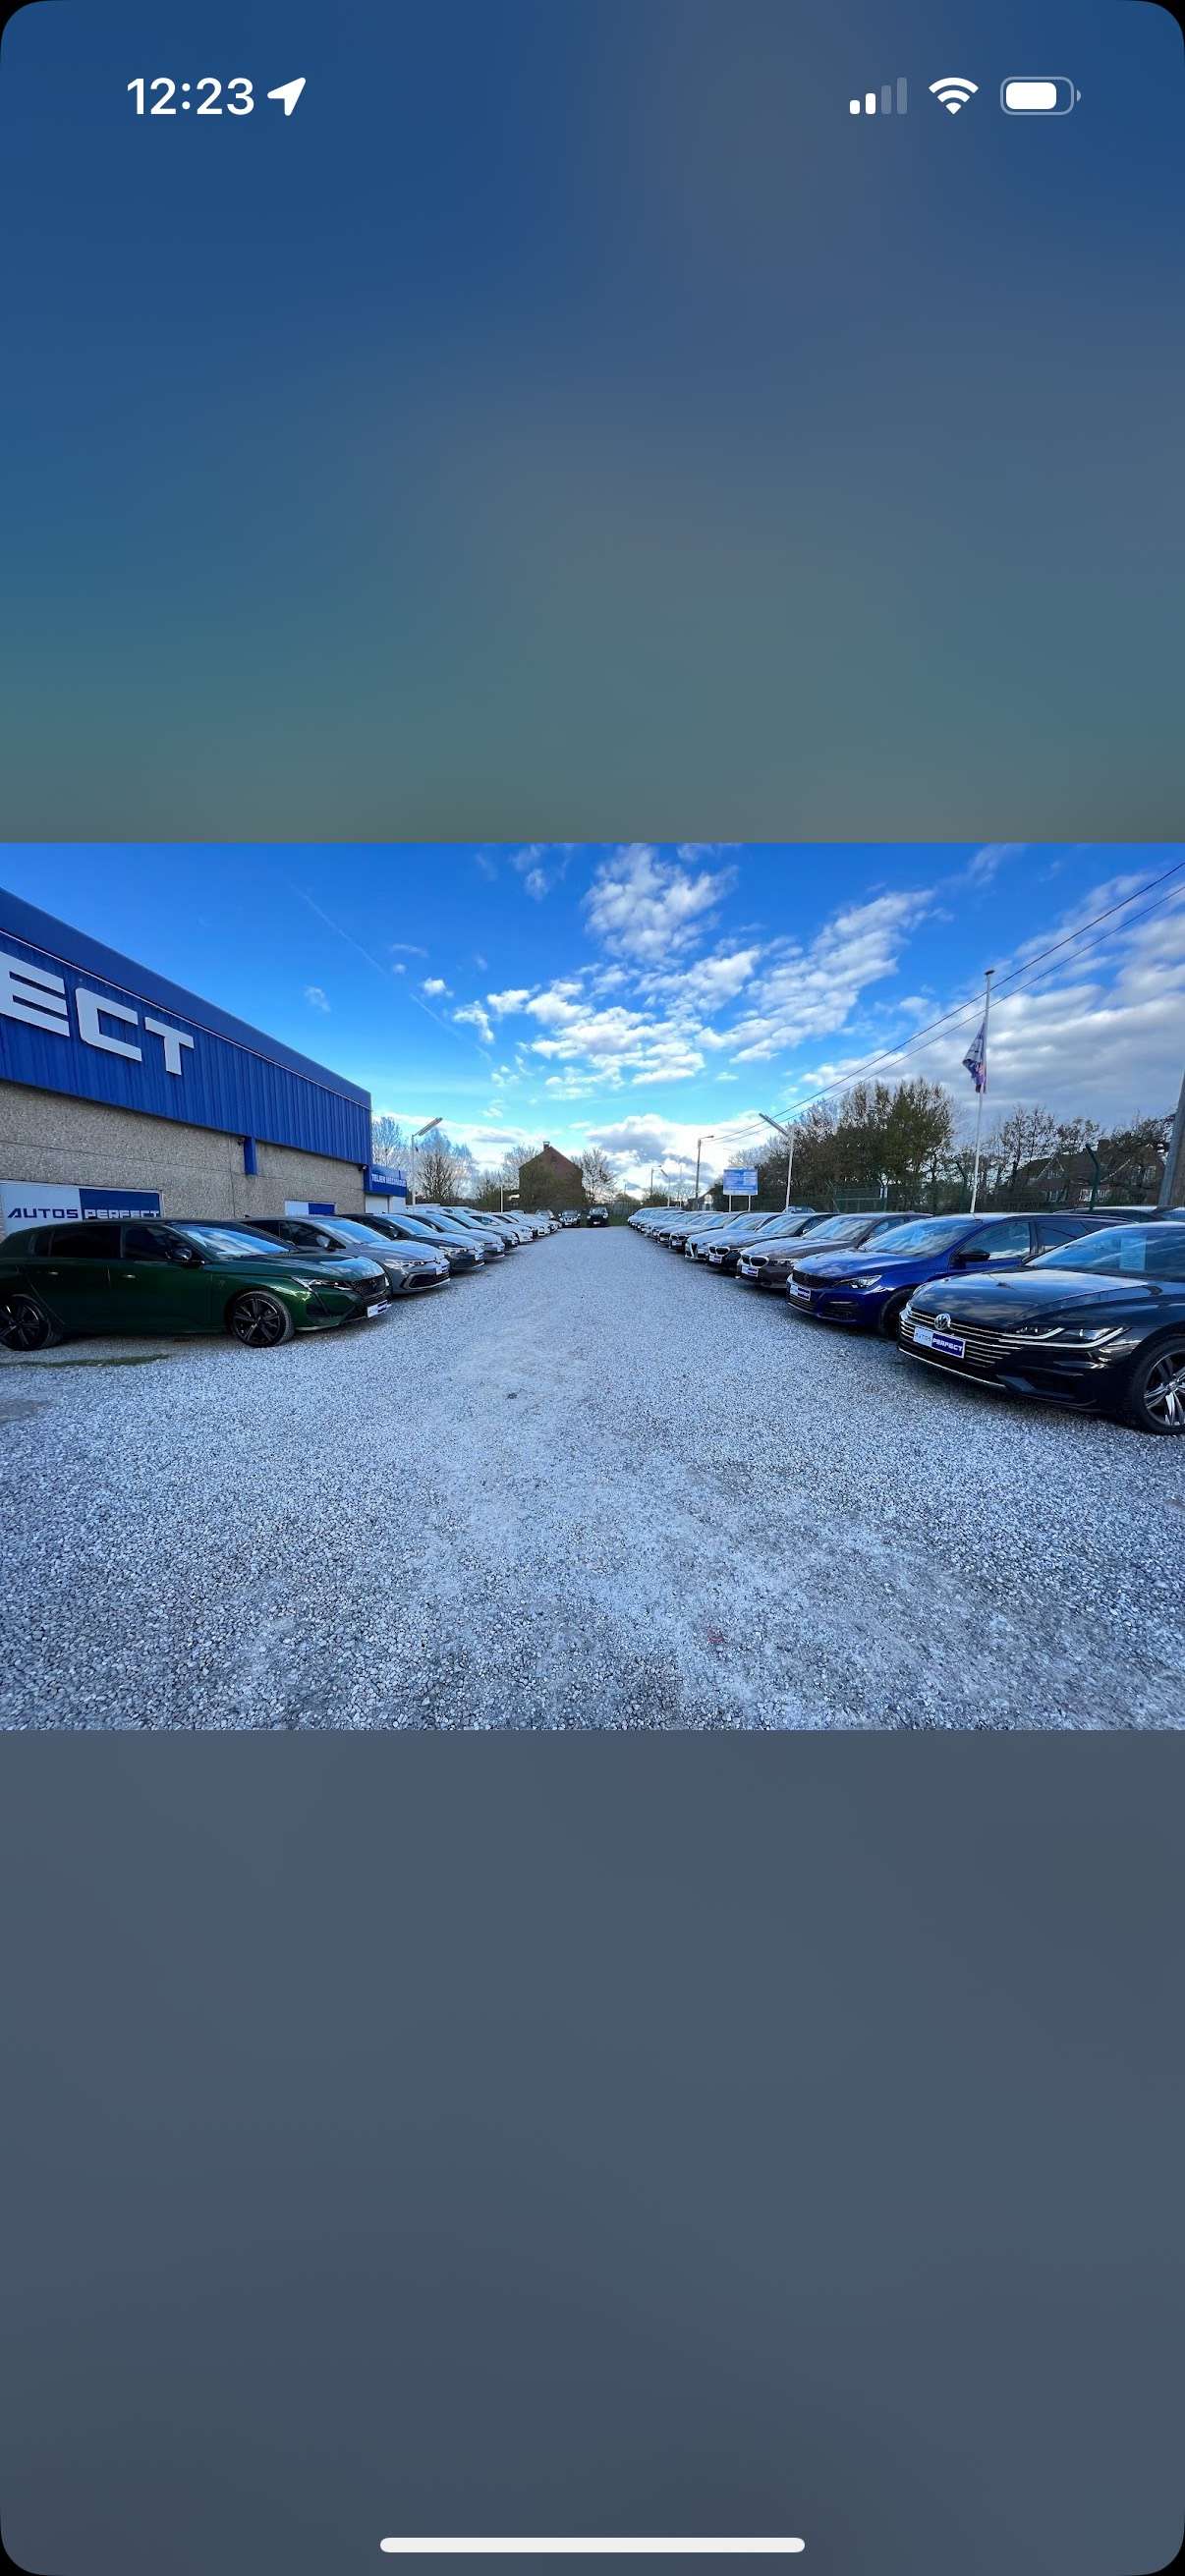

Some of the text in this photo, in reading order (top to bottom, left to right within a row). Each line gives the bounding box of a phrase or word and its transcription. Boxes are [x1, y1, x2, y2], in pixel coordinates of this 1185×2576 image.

[8, 1207, 160, 1220] AUTOS PERFECT
[932, 1337, 963, 1352] PERFECT
